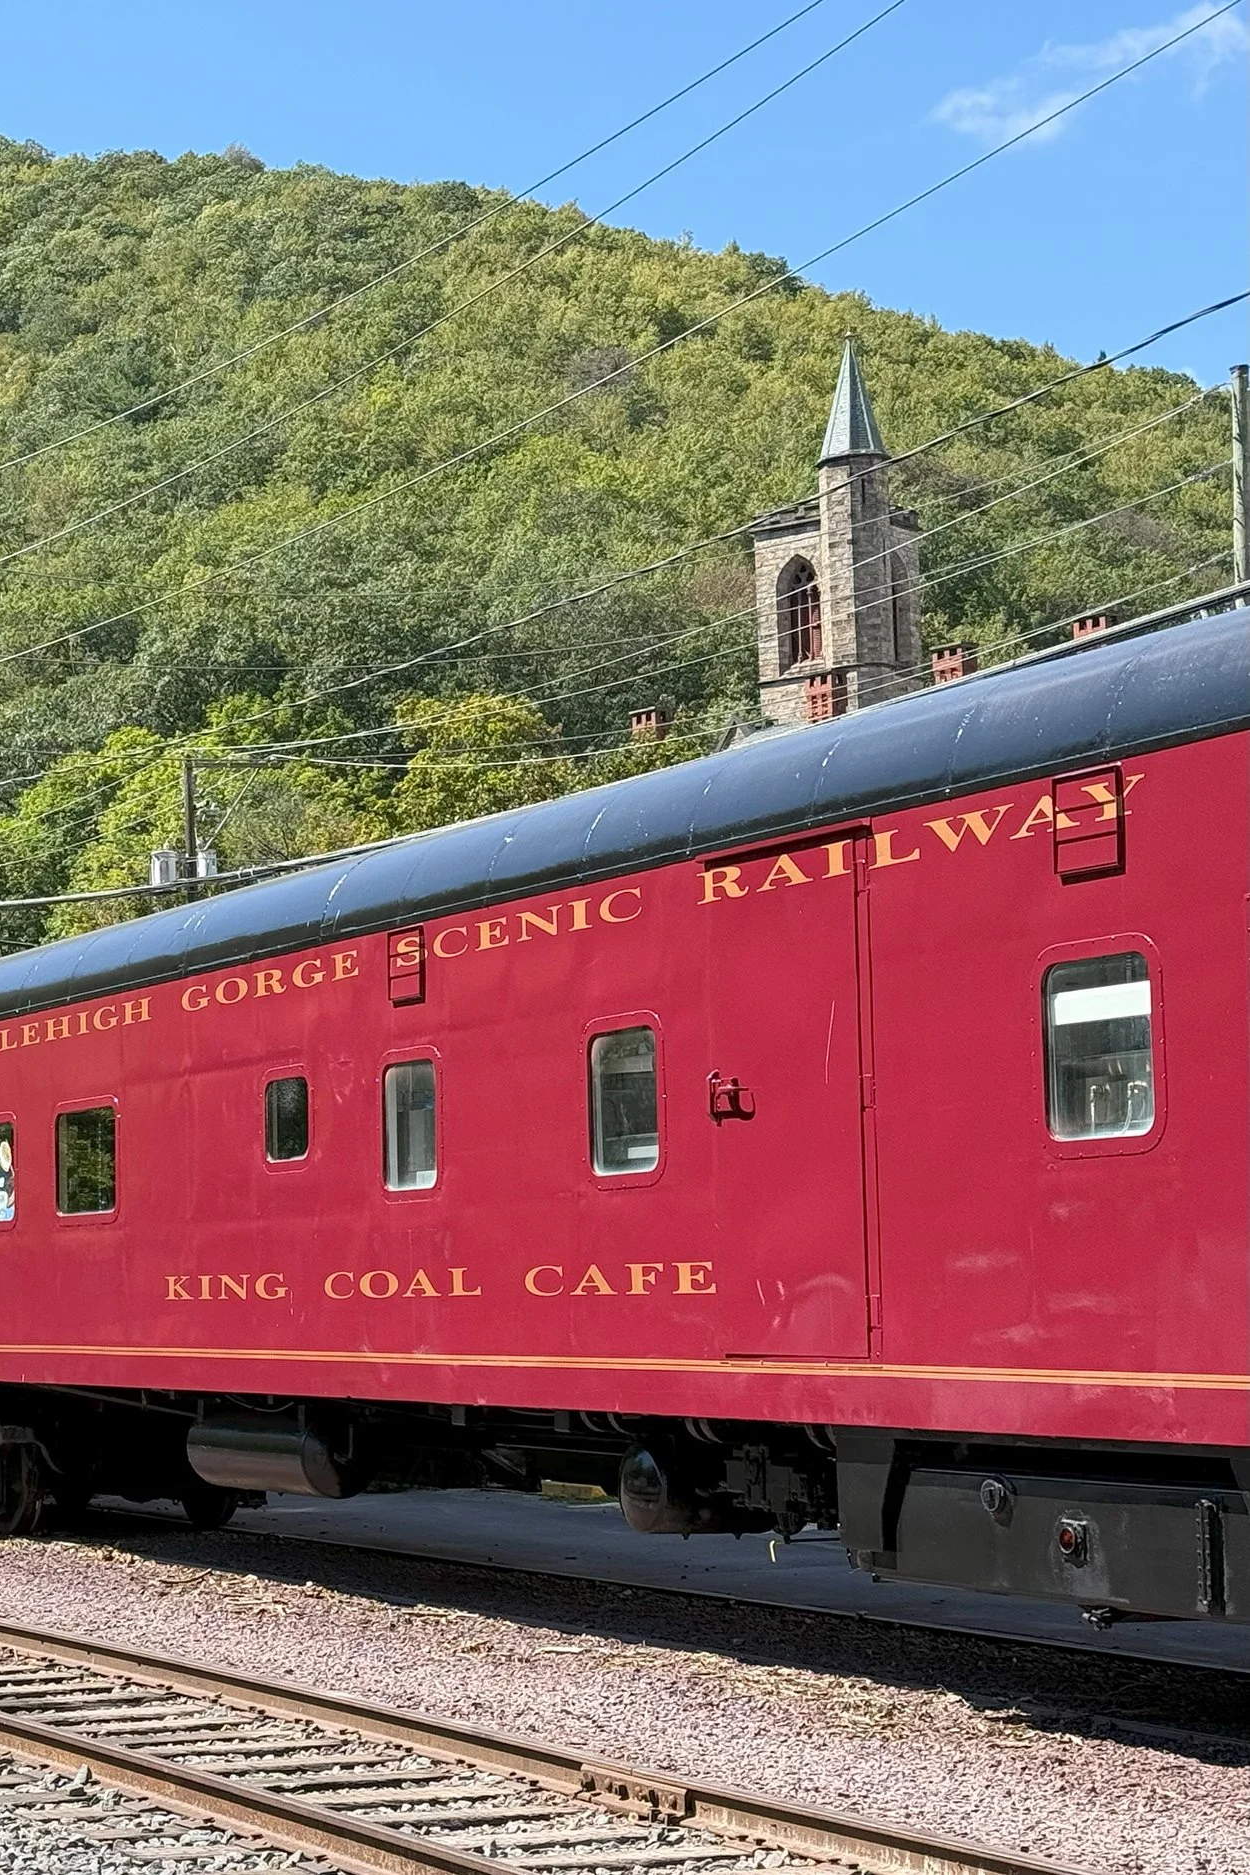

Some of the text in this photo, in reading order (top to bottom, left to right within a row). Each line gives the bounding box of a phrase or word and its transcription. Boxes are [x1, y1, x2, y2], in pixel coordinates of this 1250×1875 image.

[180, 948, 360, 1013] GORGE
[395, 886, 644, 969] SCENIC
[696, 773, 1146, 906] RAILWAY
[163, 1260, 718, 1301] KING COAL CAFE
